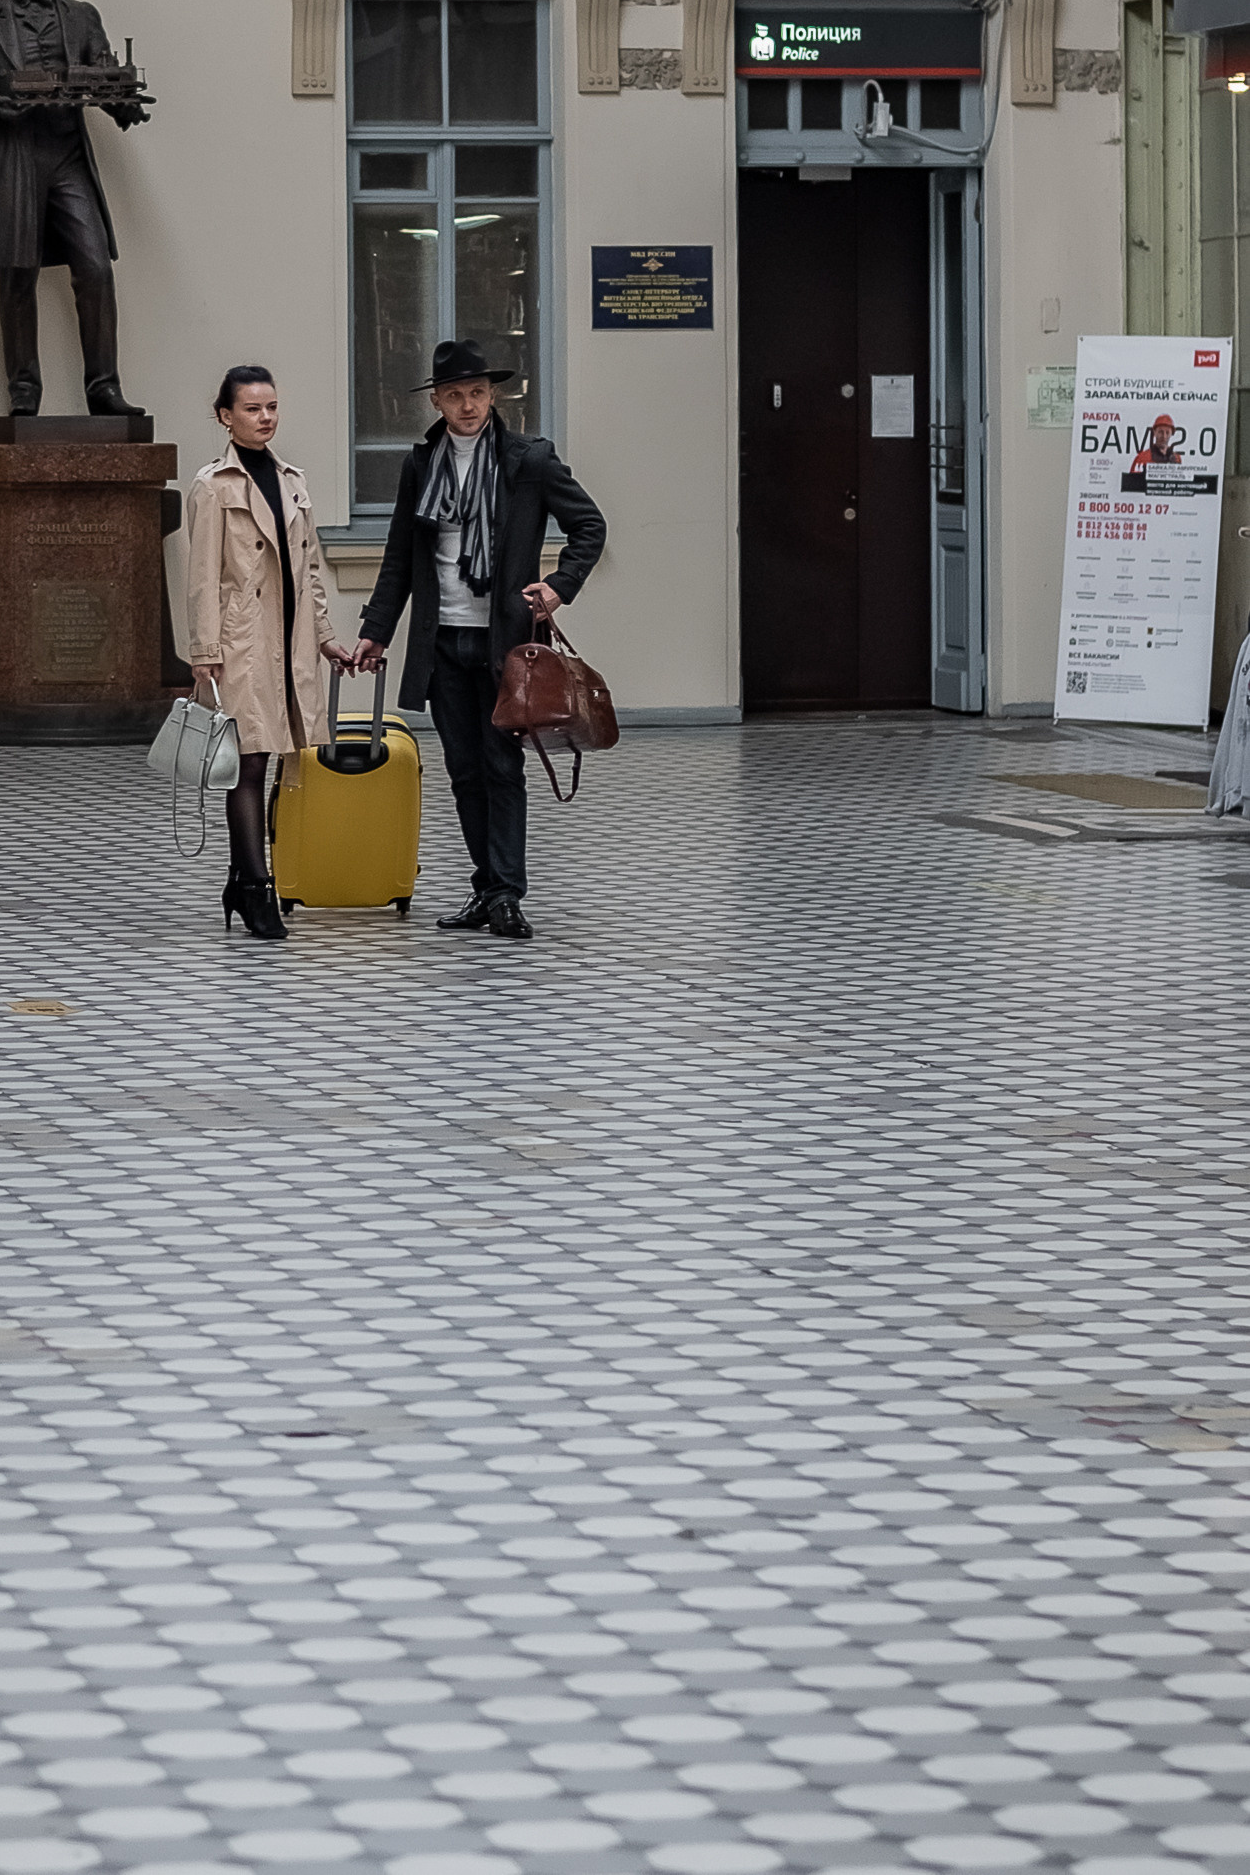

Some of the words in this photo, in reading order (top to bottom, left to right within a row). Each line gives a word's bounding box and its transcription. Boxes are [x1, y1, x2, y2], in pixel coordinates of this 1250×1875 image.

[781, 23, 862, 43] Полиция
[781, 47, 819, 61] Police
[1085, 377, 1121, 387] СТРОЙ
[1123, 378, 1174, 389] БУДУЩЕЕ
[1084, 390, 1170, 401] ЗАРАБАТЫВАЙ
[1172, 391, 1218, 402] СЕЙЧАС
[1082, 412, 1121, 421] РАБОТА
[1081, 425, 1154, 454] БАМ
[1171, 427, 1217, 456] 2.0
[1078, 501, 1086, 512] 8
[1089, 502, 1110, 513] 800
[1113, 503, 1134, 514] 500
[1138, 504, 1152, 514] 12
[1155, 504, 1170, 515] 07
[1077, 521, 1083, 529] 8
[1085, 521, 1102, 530] 812
[1104, 522, 1120, 531] 436
[1077, 530, 1082, 538] 8
[1085, 530, 1101, 539] 812
[1104, 531, 1120, 540] 436
[1136, 532, 1146, 541] 71
[1083, 652, 1120, 660] ВАКАНСИИ
